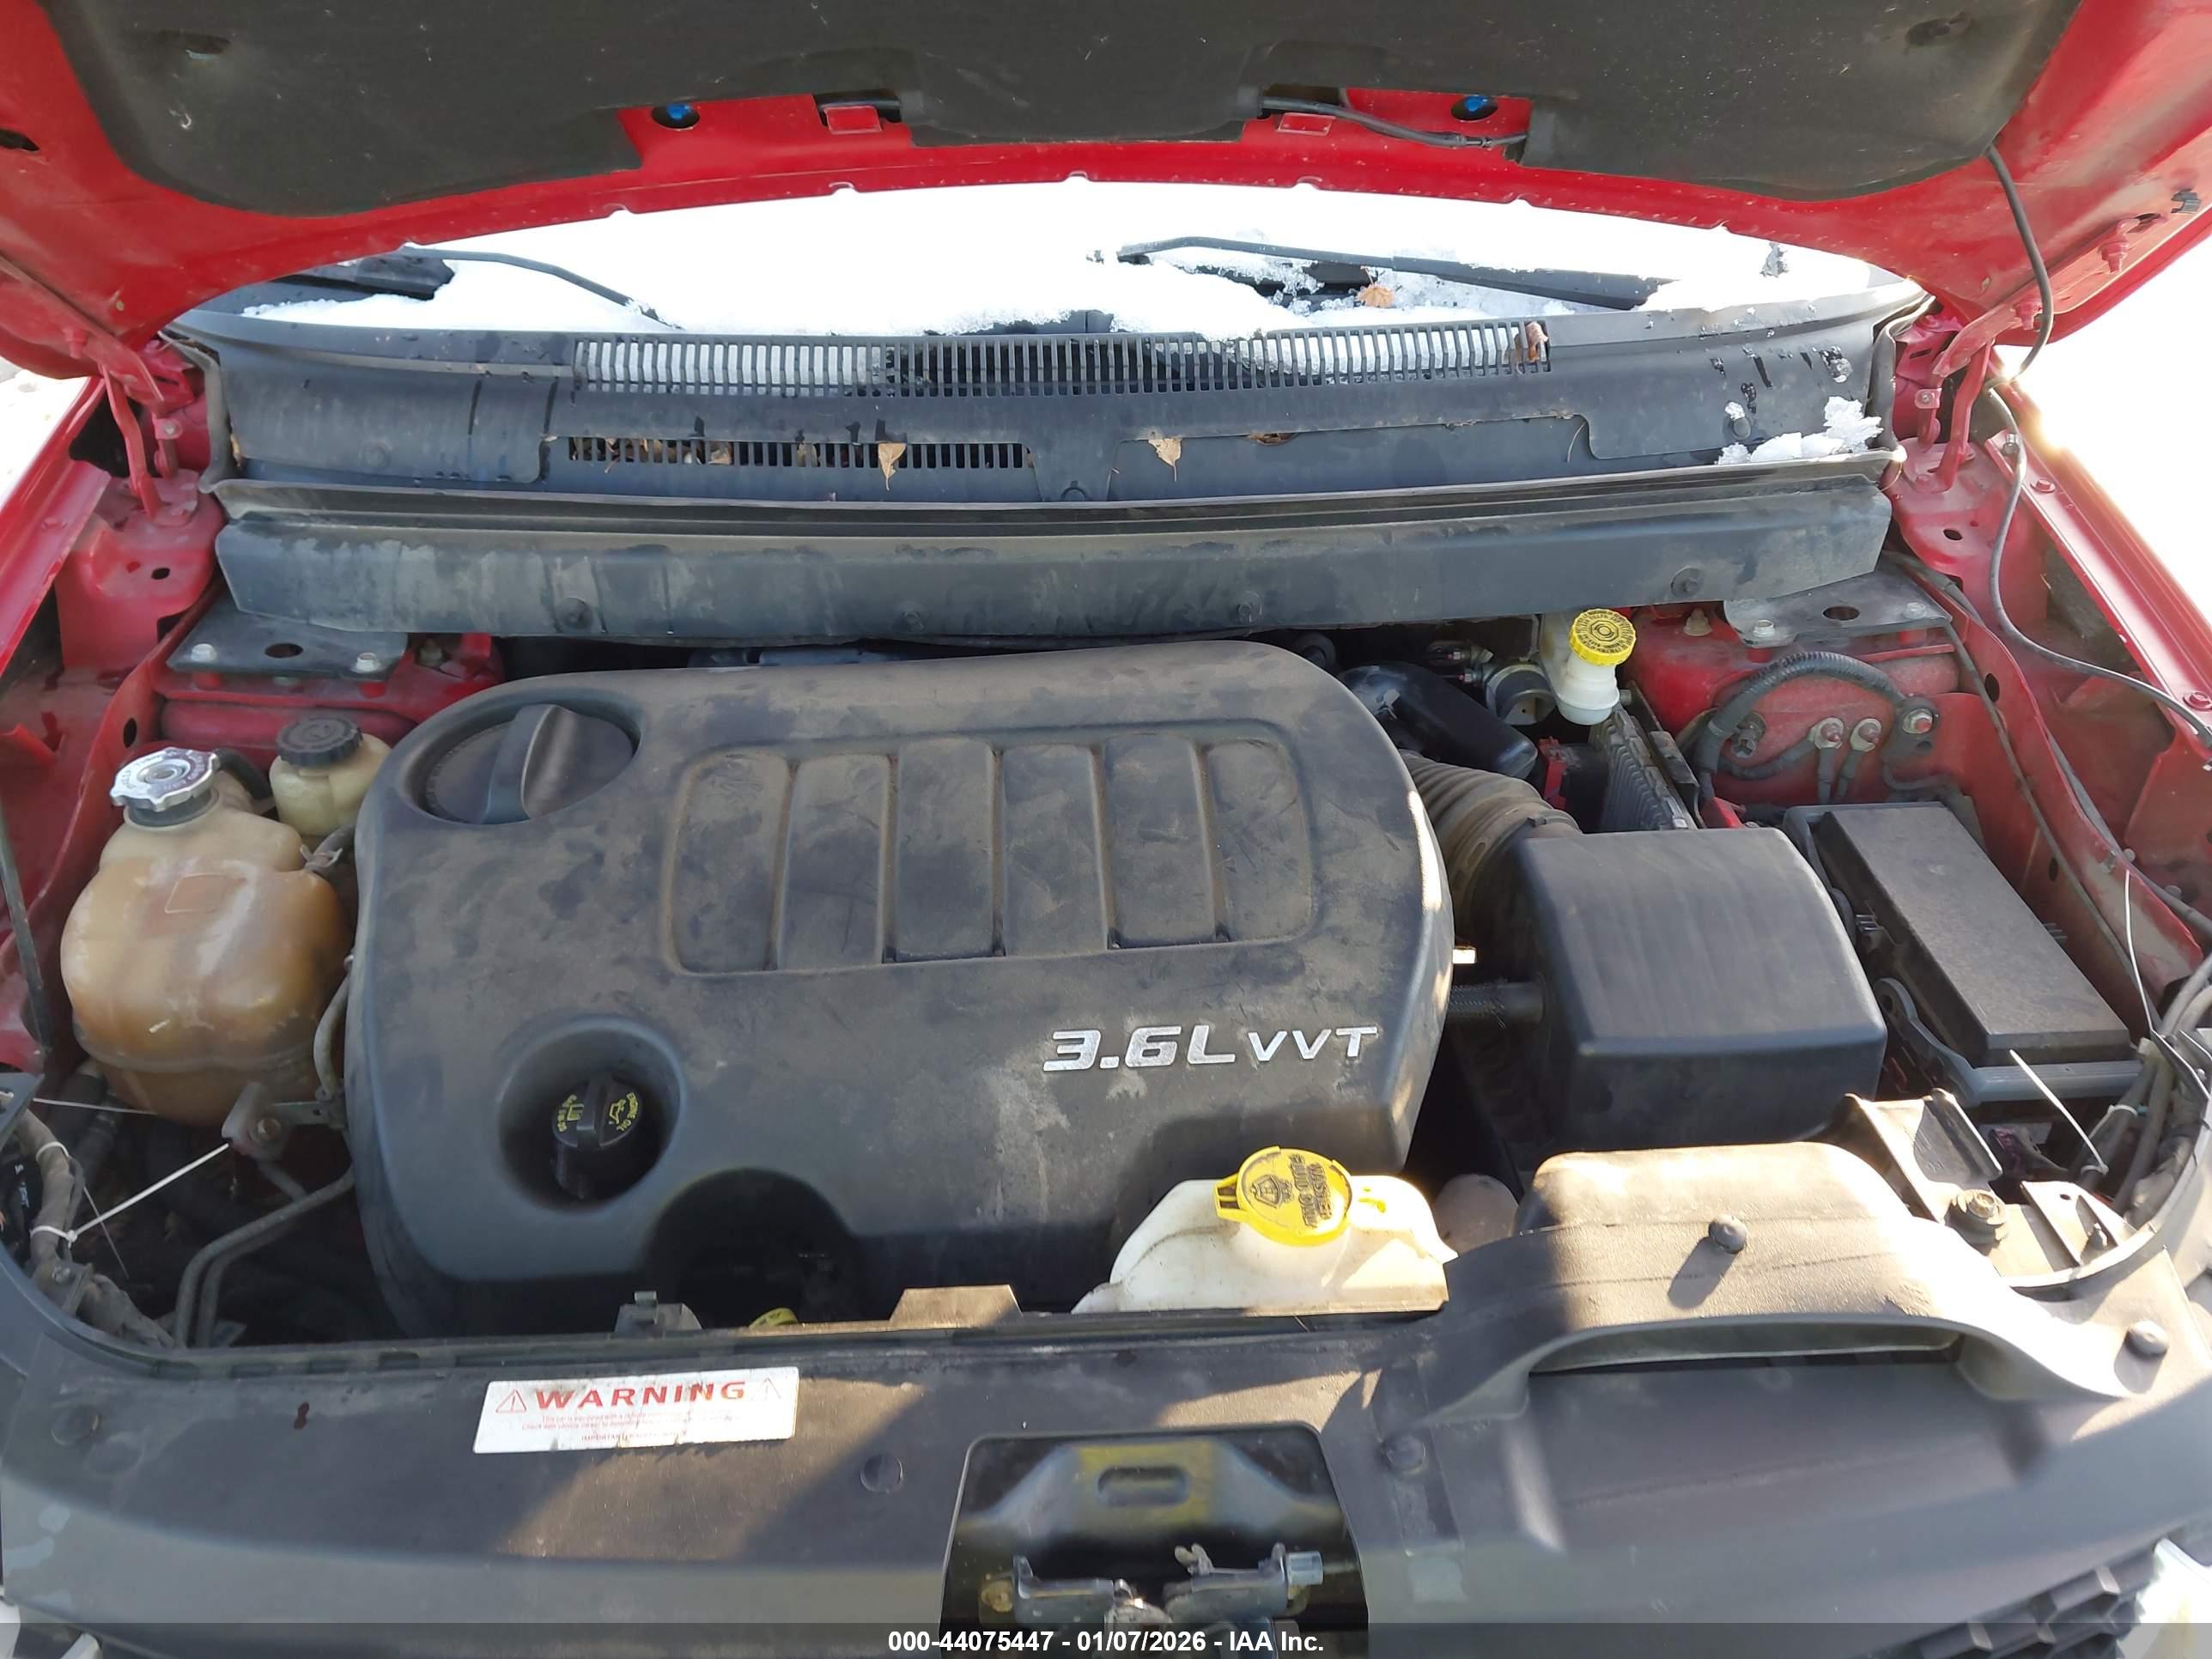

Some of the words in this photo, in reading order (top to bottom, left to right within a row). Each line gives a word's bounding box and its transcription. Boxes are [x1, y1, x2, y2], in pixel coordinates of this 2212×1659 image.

[1042, 1024, 1237, 1072] 3.6L
[1248, 1026, 1379, 1062] VVT
[616, 1119, 632, 1132] OIL
[1290, 1154, 1309, 1190] FLUID
[1310, 1163, 1333, 1219] WASHER
[535, 1381, 745, 1409] WARNING
